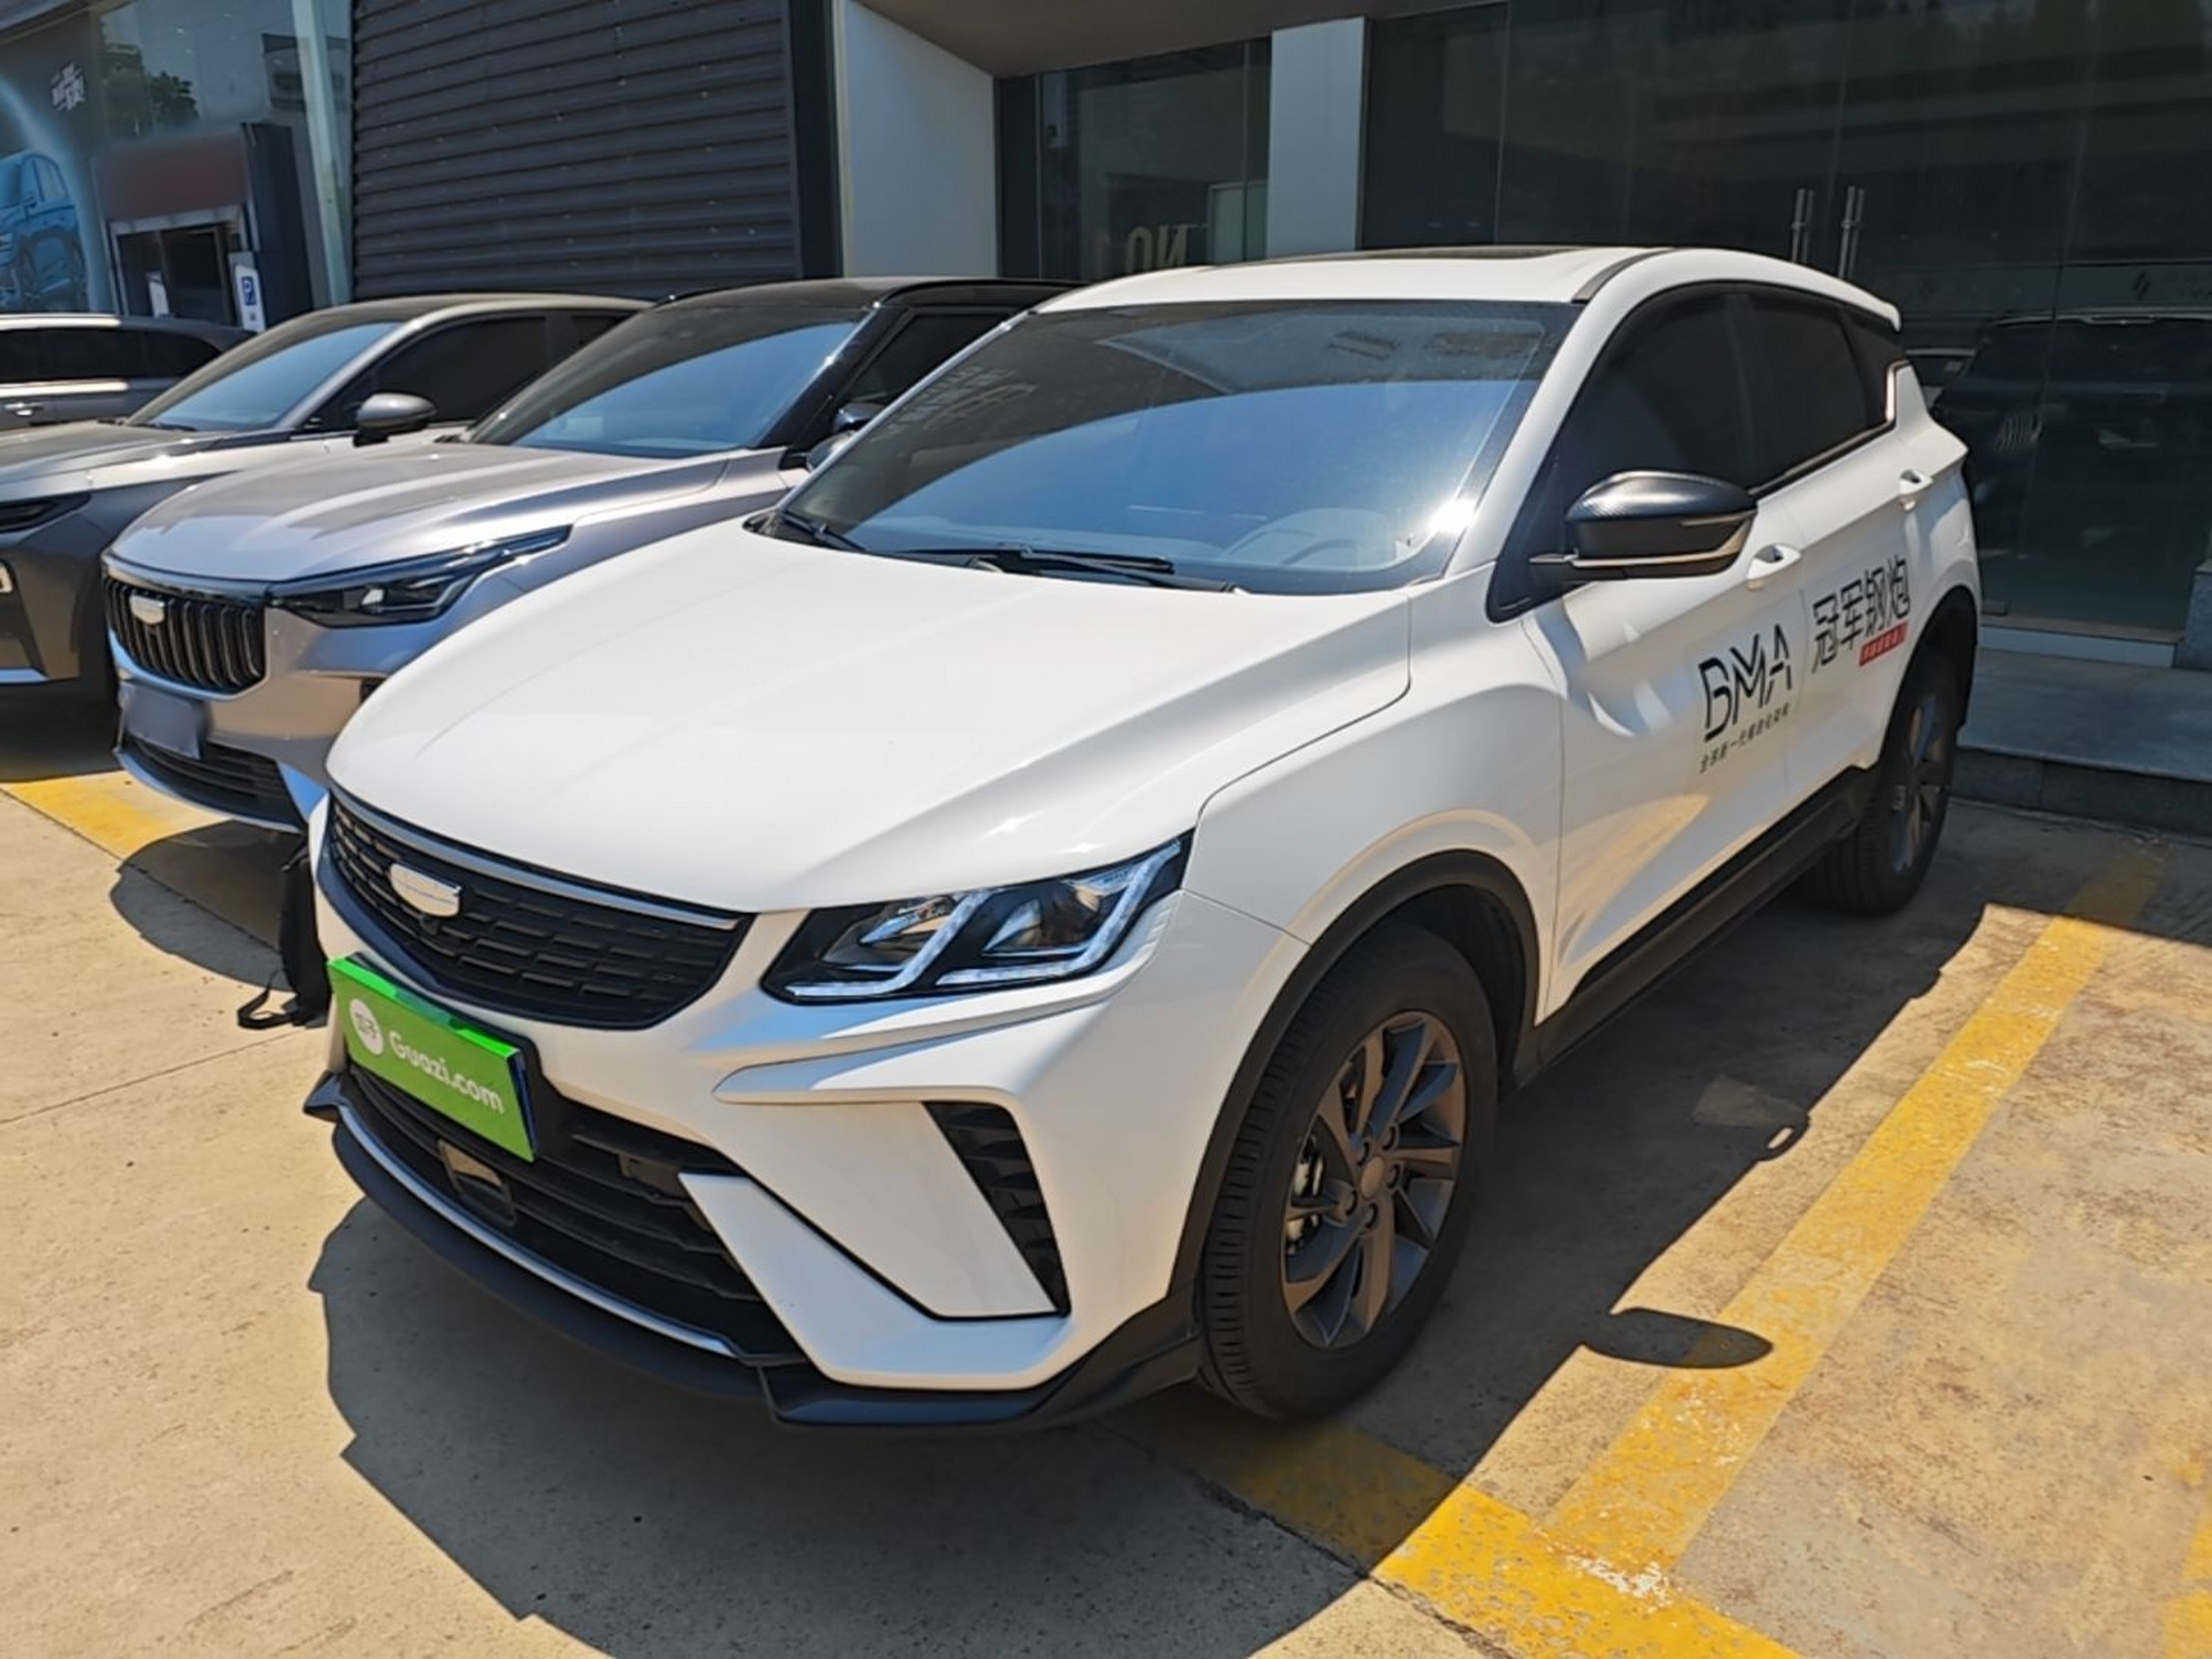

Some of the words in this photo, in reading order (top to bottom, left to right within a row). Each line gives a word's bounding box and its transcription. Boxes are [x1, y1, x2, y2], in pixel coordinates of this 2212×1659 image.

[1811, 554, 1911, 673] 冠军钢炮
[1698, 623, 1792, 742] BMA
[389, 1030, 505, 1114] Guazi.com
